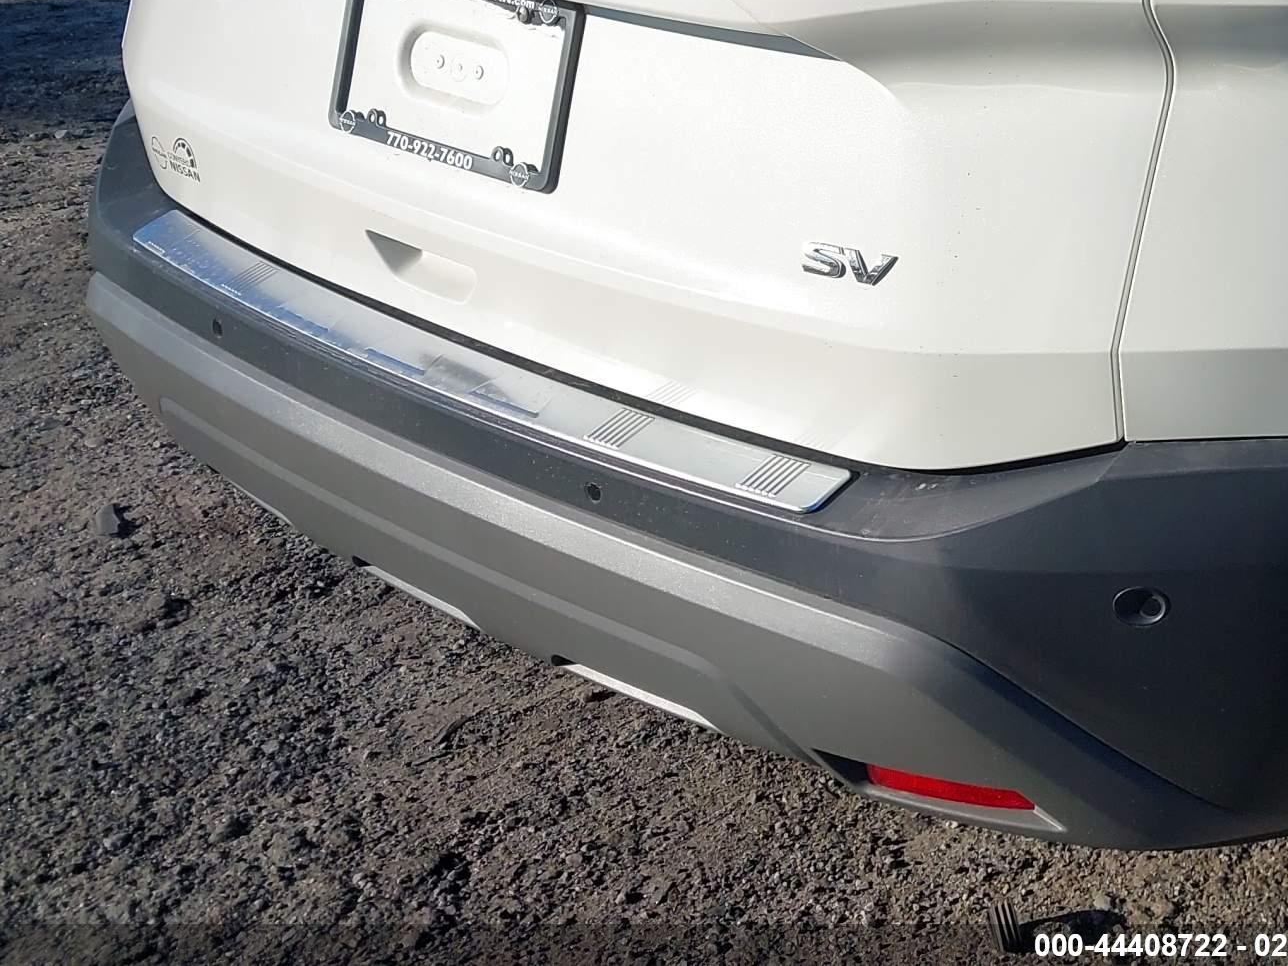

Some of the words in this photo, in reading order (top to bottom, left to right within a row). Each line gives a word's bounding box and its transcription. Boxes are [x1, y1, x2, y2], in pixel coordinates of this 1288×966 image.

[386, 131, 473, 170] 770-922-7600
[170, 160, 200, 183] NISSAN
[802, 242, 899, 286] SV
